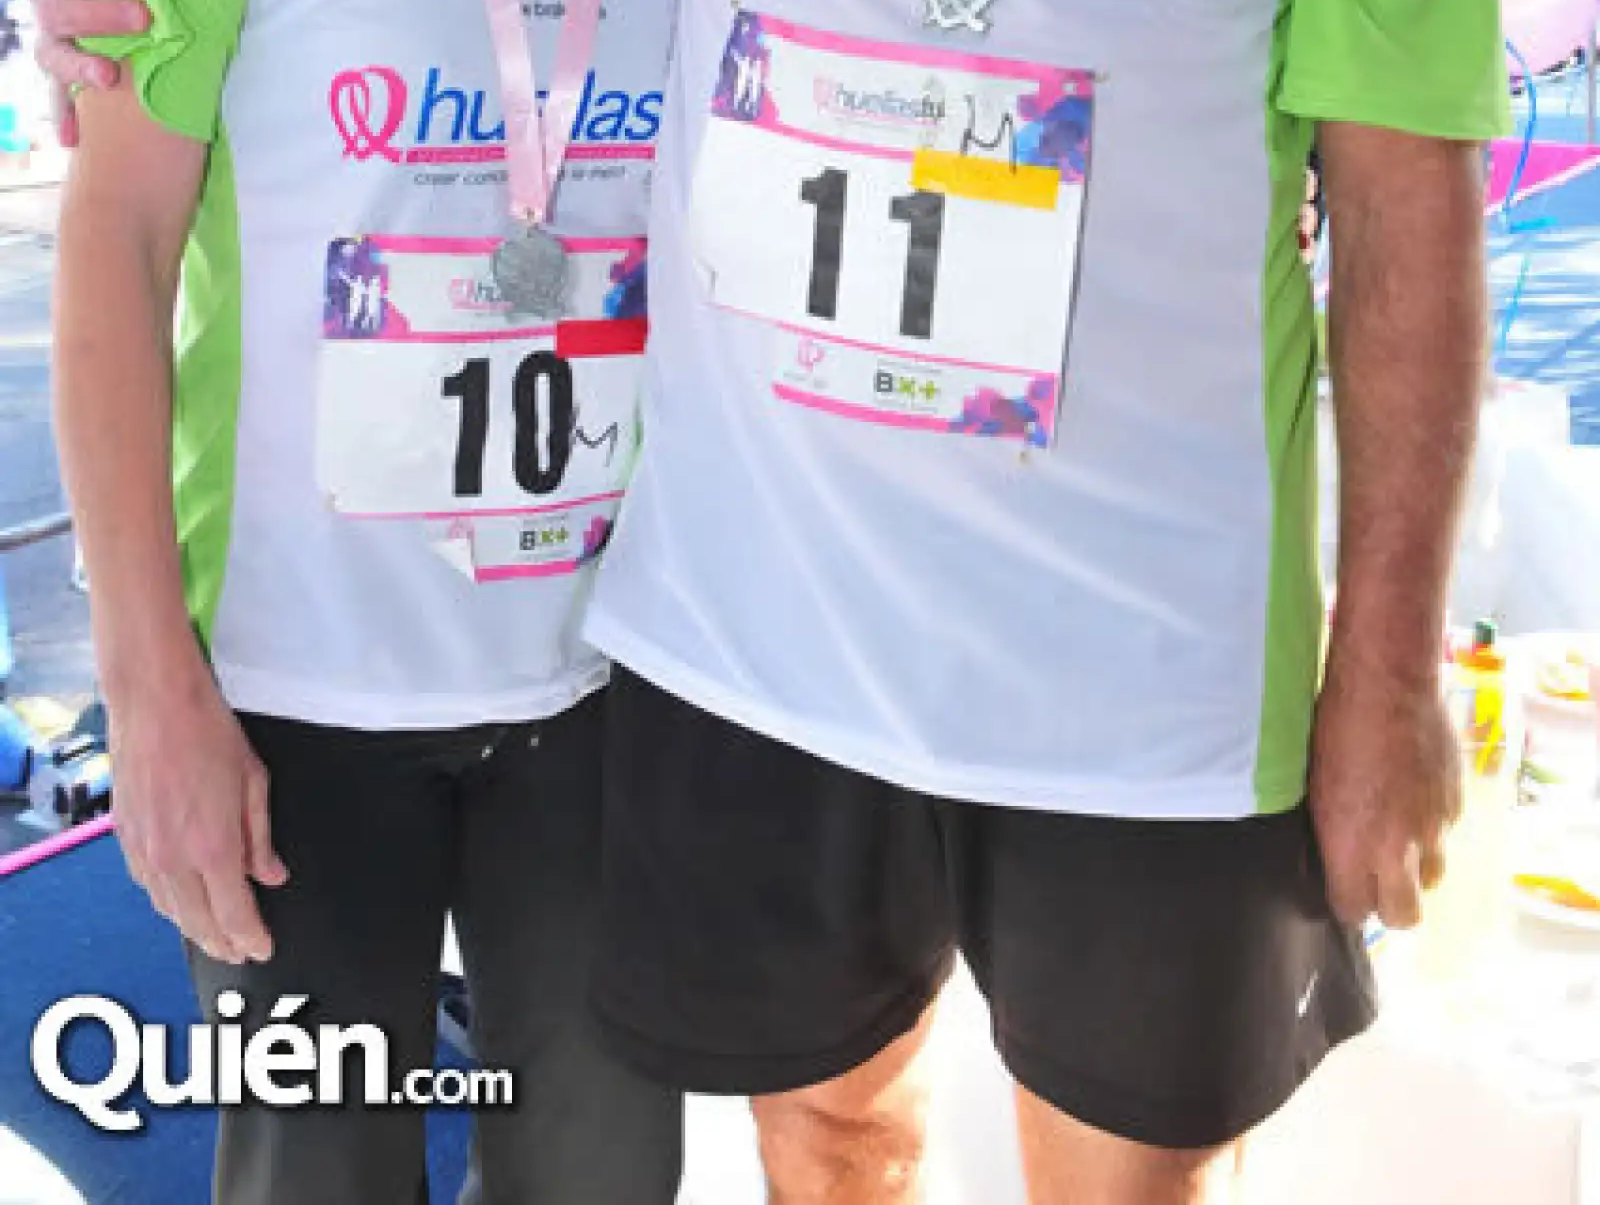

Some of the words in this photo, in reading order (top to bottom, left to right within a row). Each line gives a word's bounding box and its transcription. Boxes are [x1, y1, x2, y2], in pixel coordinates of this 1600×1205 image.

[416, 66, 664, 144] hulas
[800, 165, 946, 340] 11
[440, 350, 573, 498] 10
